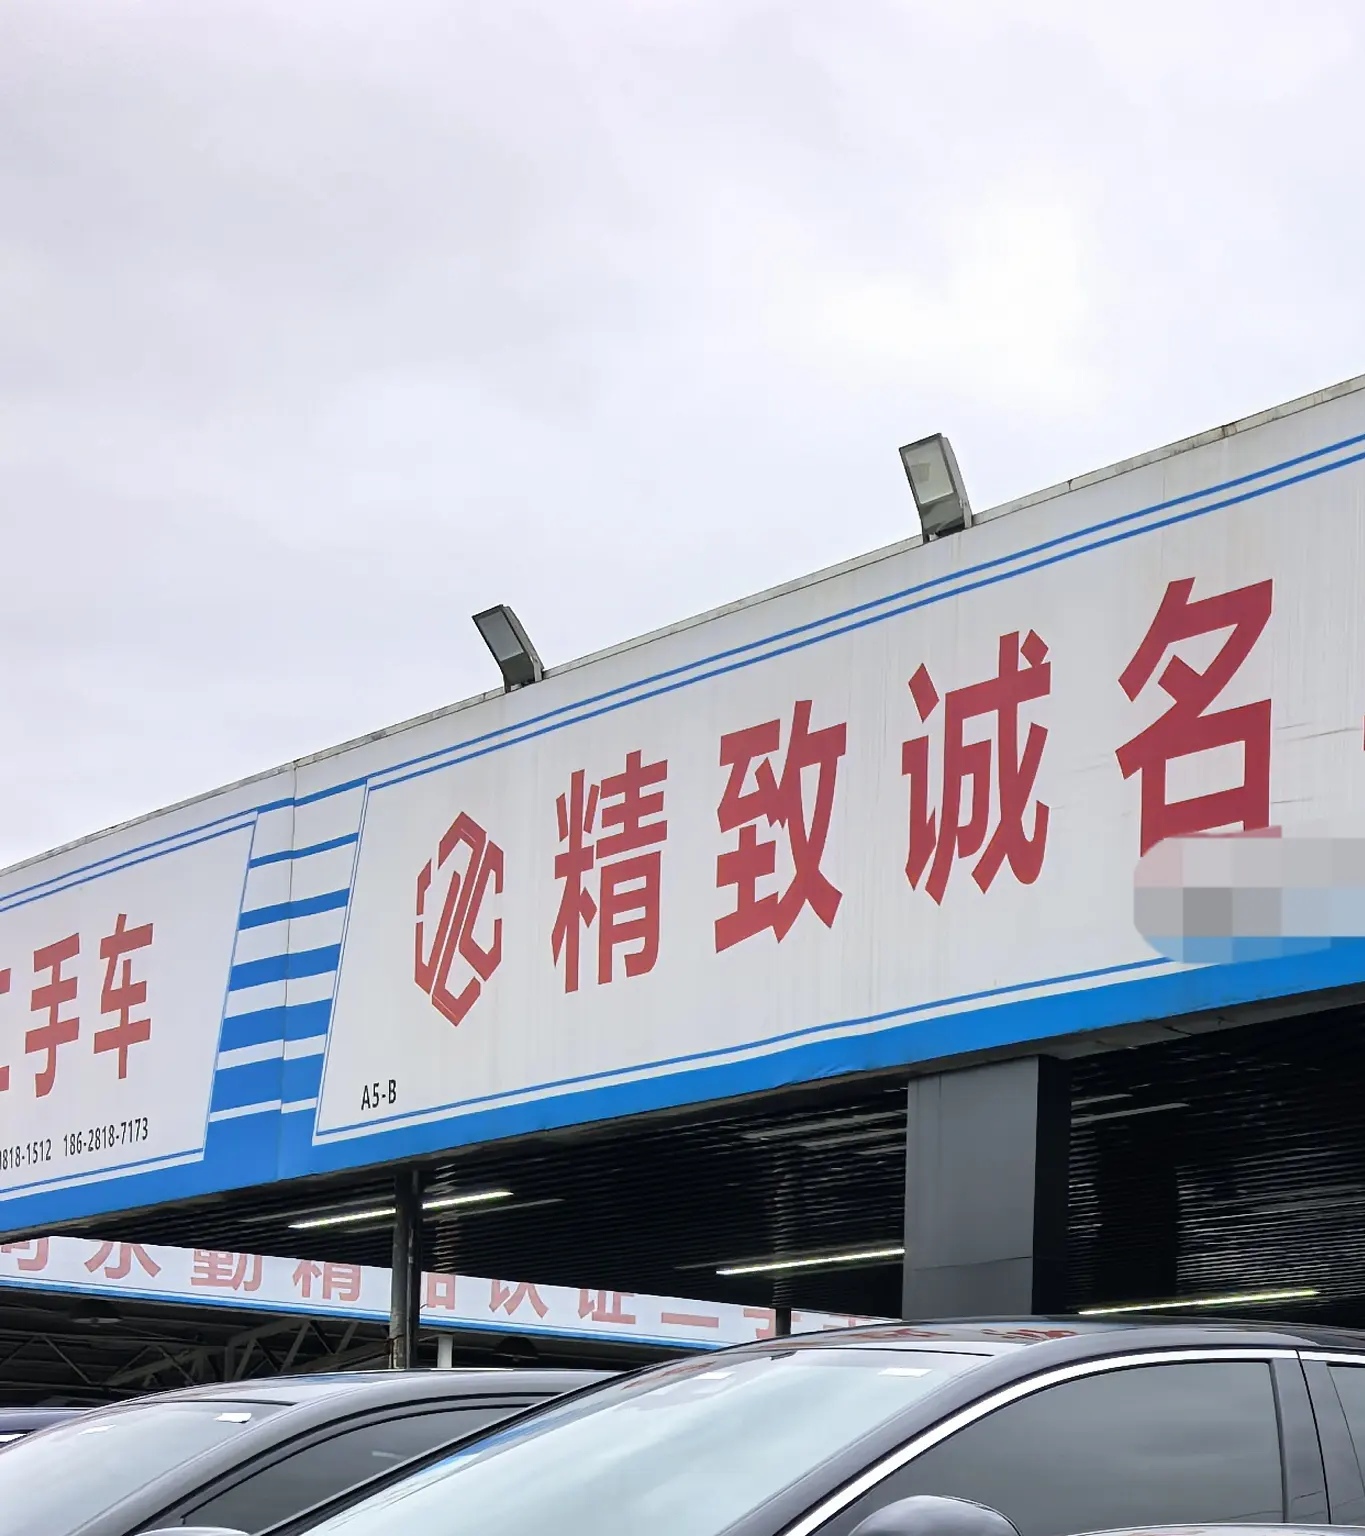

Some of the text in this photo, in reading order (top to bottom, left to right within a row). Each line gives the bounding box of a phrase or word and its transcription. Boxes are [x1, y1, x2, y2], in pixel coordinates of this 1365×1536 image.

[0, 913, 154, 1099] 手车
[360, 1079, 398, 1111] A5-B
[0, 1117, 149, 1171] 818-1512 186-2818-7173
